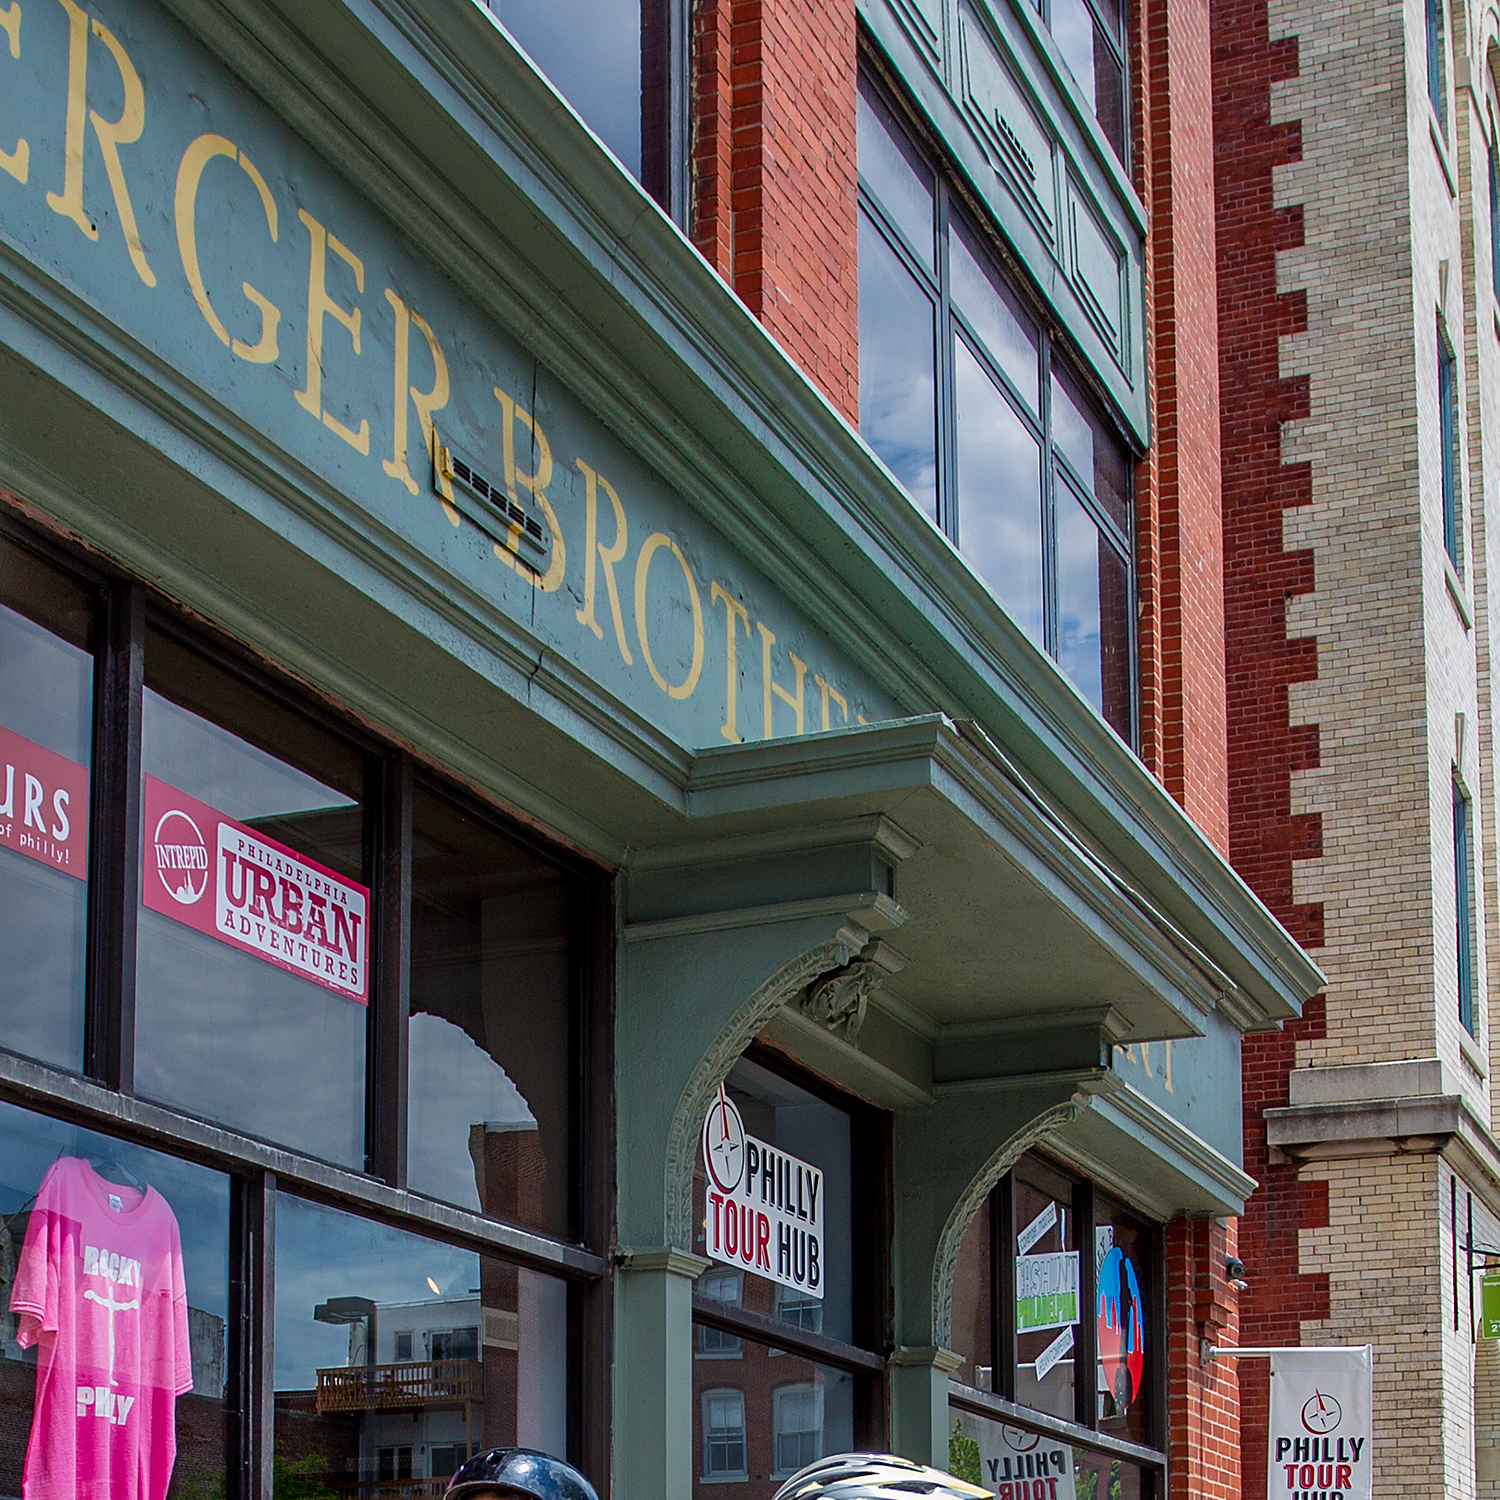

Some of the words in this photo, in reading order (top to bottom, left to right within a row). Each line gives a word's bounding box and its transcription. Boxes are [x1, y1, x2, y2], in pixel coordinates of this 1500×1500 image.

[495, 388, 868, 743] BROTH
[20, 832, 70, 865] philly!
[155, 843, 208, 871] INTREPID
[237, 838, 349, 905] PHILADELPHIA
[222, 848, 361, 962] URBAN
[225, 910, 358, 986] ADVENTURES
[745, 1140, 819, 1225] PHILLY
[83, 1245, 141, 1288] ROCKY
[709, 1192, 770, 1272] TOUR
[777, 1221, 820, 1291] HUB
[1275, 1437, 1364, 1463] PHILLY
[1283, 1463, 1352, 1490] TOUR
